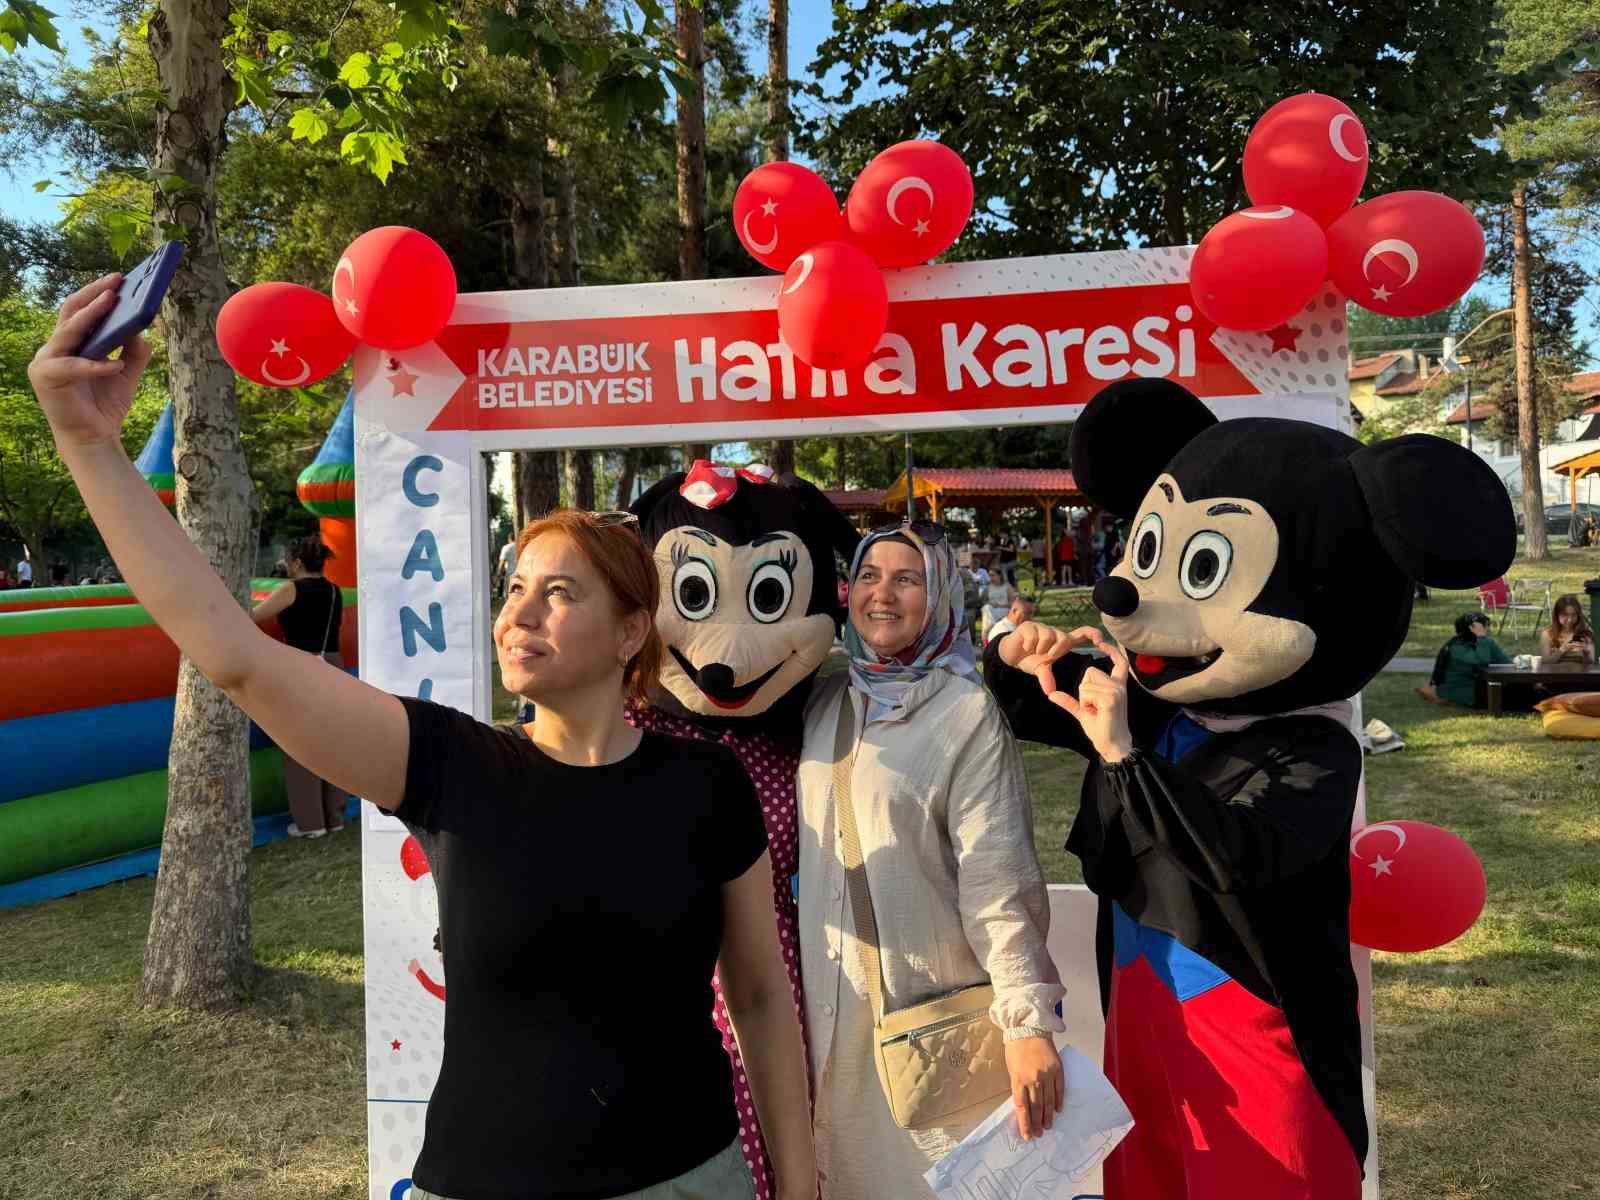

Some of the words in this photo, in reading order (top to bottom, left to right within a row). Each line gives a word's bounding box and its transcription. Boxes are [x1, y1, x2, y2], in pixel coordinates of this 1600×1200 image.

[477, 341, 652, 378] KARABÜK
[940, 304, 1197, 392] Karesi
[478, 377, 653, 409] BELEDİYESİ
